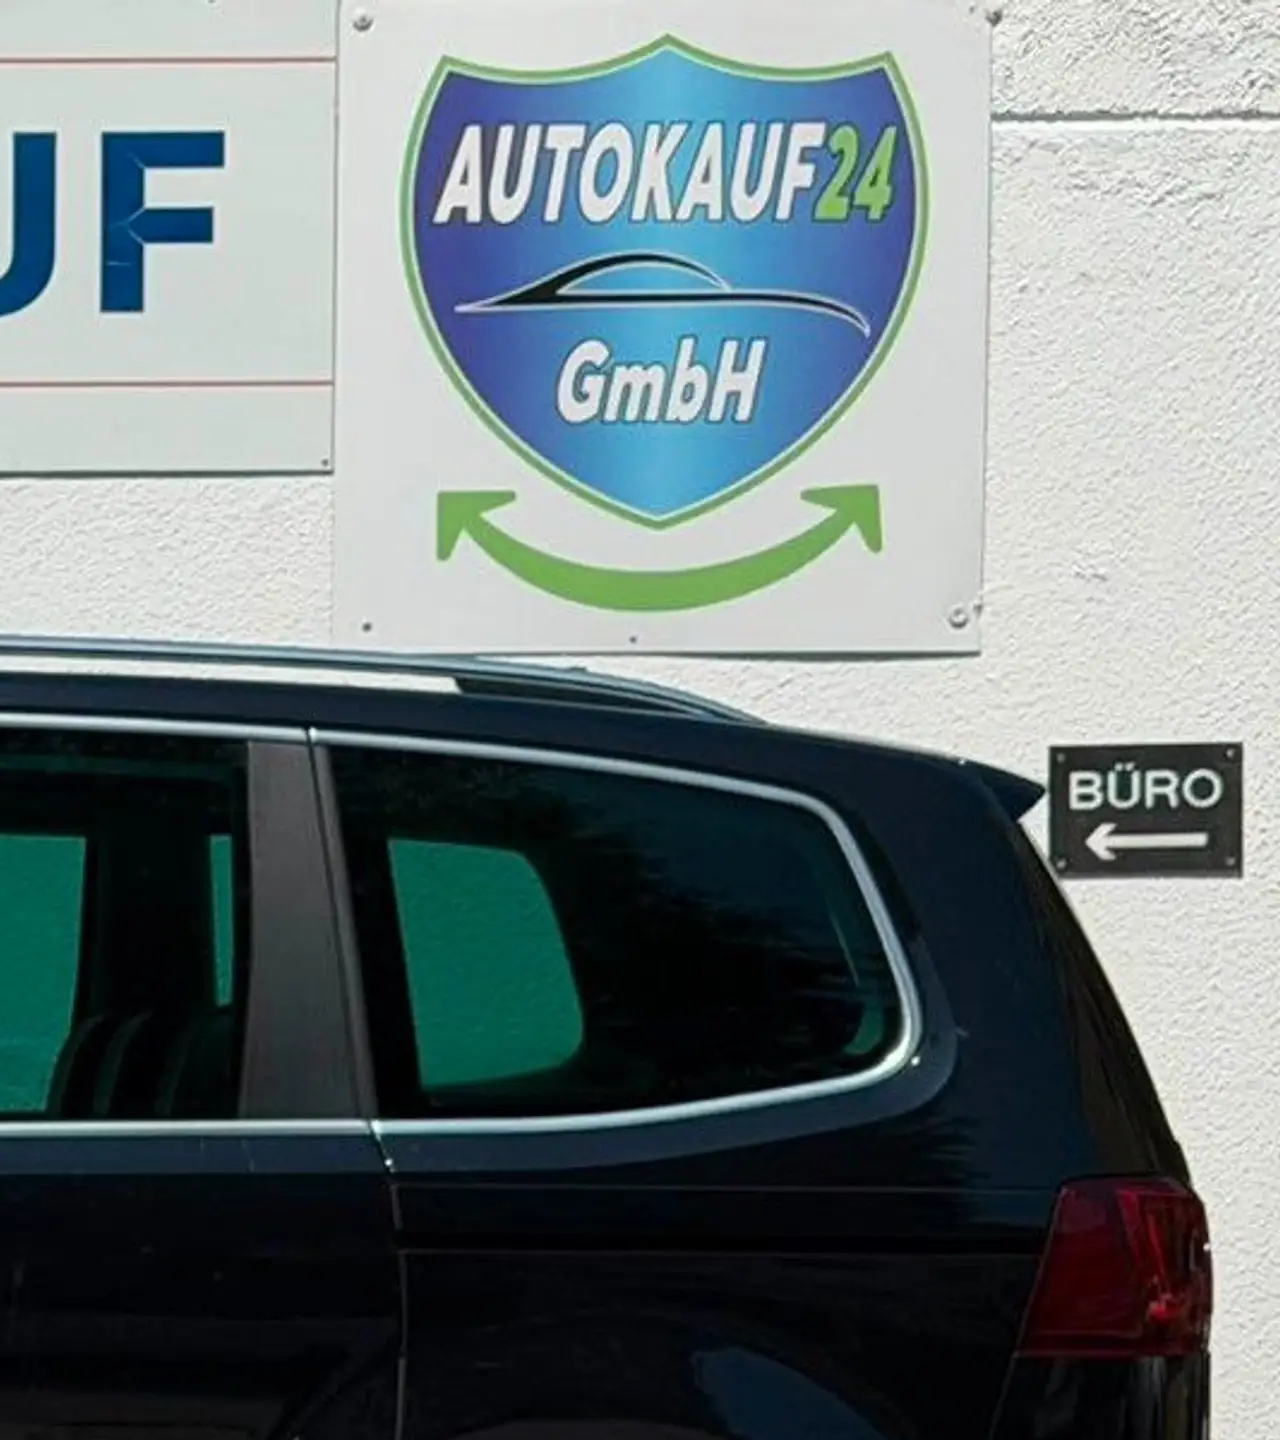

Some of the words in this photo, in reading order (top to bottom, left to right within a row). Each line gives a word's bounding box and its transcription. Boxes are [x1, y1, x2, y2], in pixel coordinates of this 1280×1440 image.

[433, 122, 897, 225] AUTOKAUF24
[557, 337, 766, 423] GmbH
[1068, 761, 1223, 810] BÜRO
